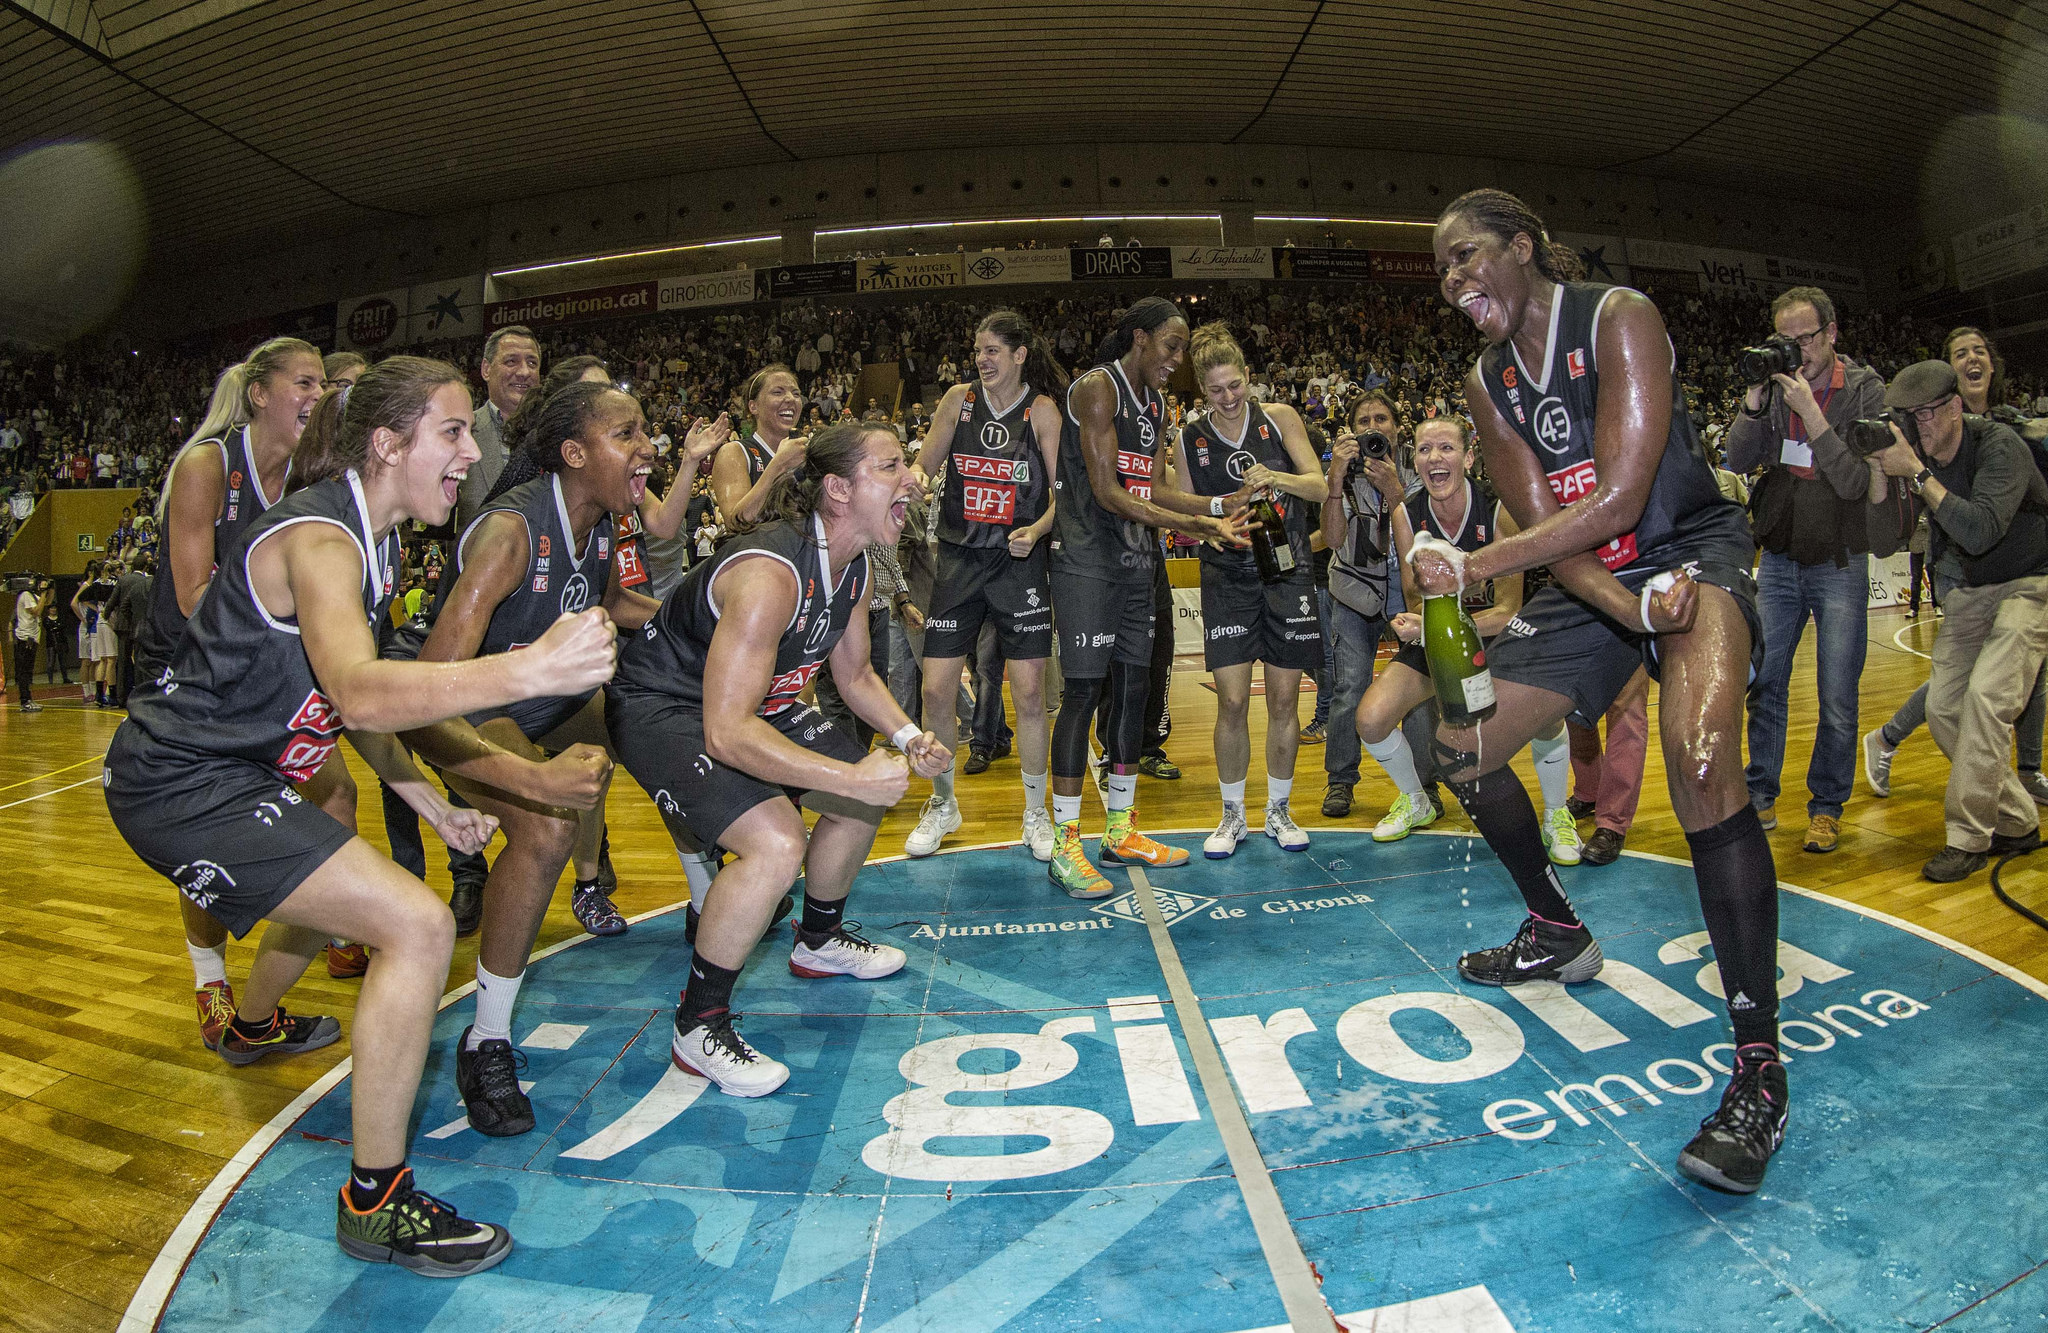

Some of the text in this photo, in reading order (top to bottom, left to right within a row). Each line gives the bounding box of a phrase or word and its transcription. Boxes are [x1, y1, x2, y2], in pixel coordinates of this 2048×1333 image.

[906, 263, 952, 273] VIATGES
[1085, 251, 1142, 275] DRAPS
[1386, 261, 1433, 272] BAUHA
[660, 280, 752, 304] GIROROOMS
[860, 272, 958, 291] PLAIMONT
[353, 305, 391, 329] FRIT
[491, 289, 648, 325] diaridegirona.cat
[987, 426, 1003, 444] 11
[1138, 420, 1153, 441] 25
[1541, 410, 1569, 442] 43
[1550, 467, 1597, 499] PAR
[566, 583, 585, 612] 22
[1092, 632, 1116, 648] girona
[1209, 891, 1375, 921] de Girona
[910, 915, 1115, 940] Ajuntament
[862, 930, 1855, 1181] girona
[1482, 988, 1931, 1141] emocona
